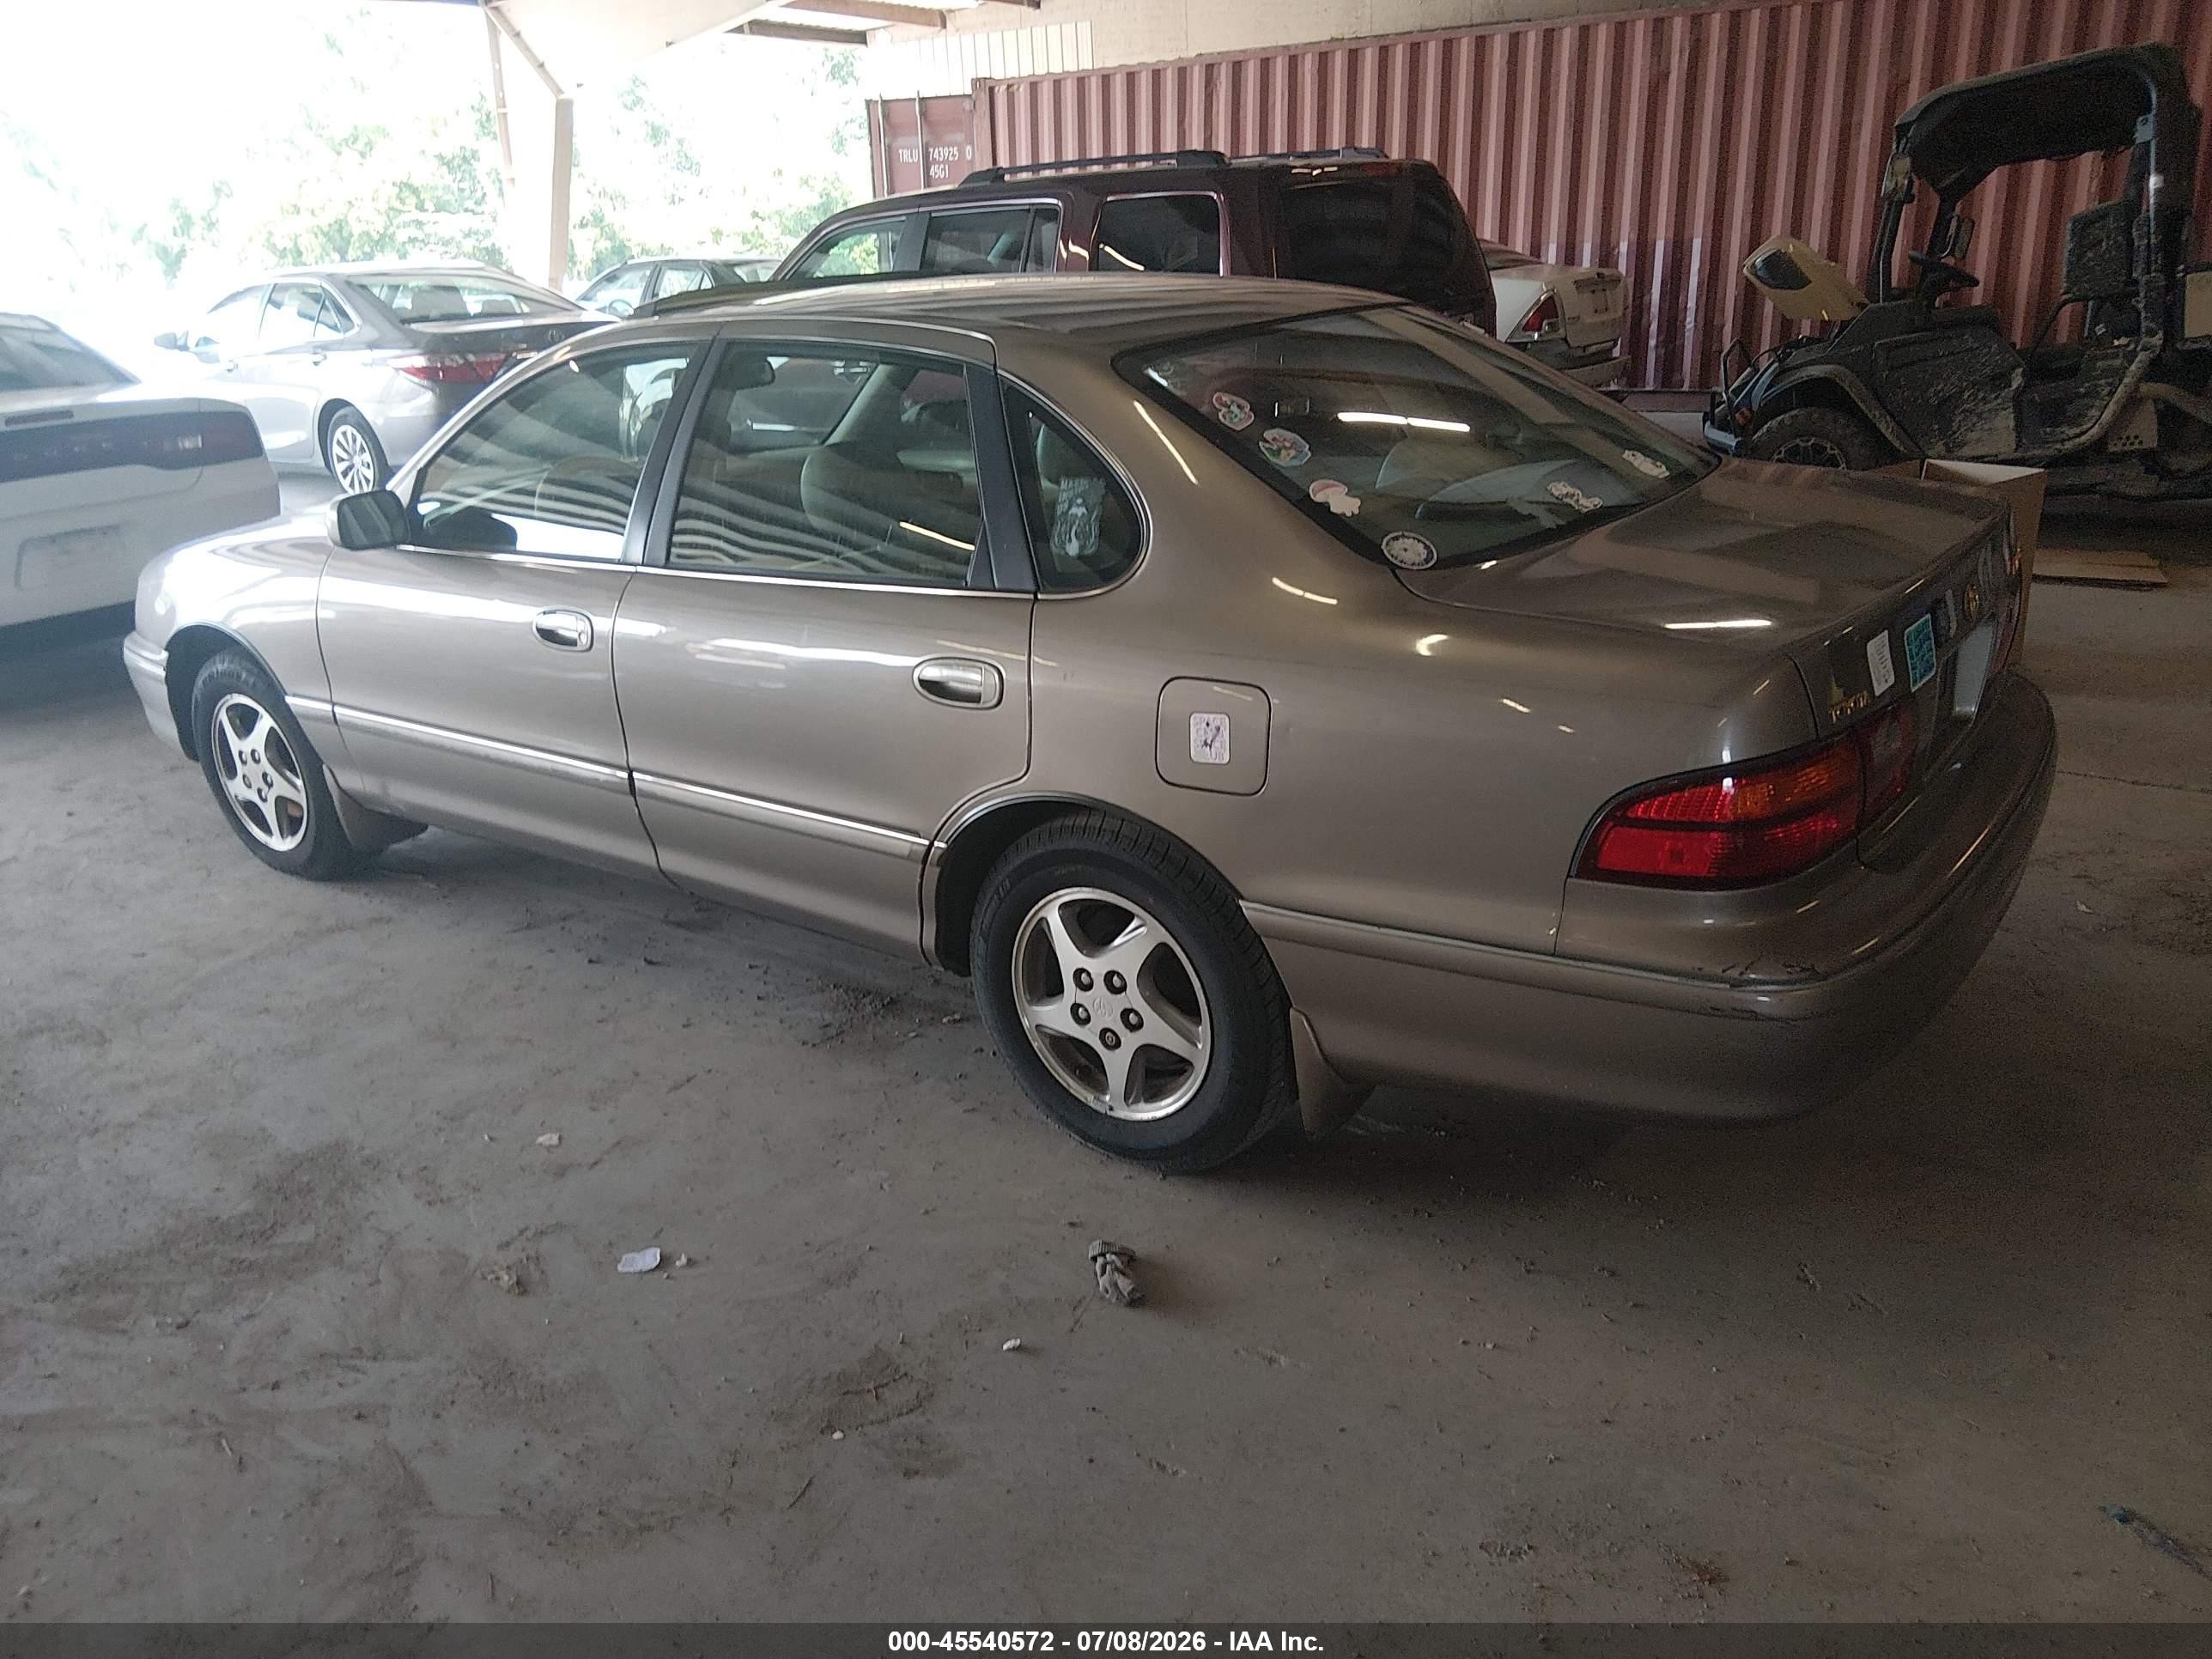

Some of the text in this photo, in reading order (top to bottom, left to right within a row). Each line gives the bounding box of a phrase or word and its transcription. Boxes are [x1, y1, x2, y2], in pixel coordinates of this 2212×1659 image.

[898, 145, 972, 163] TRLU 743925 0
[930, 165, 948, 179] 45G1
